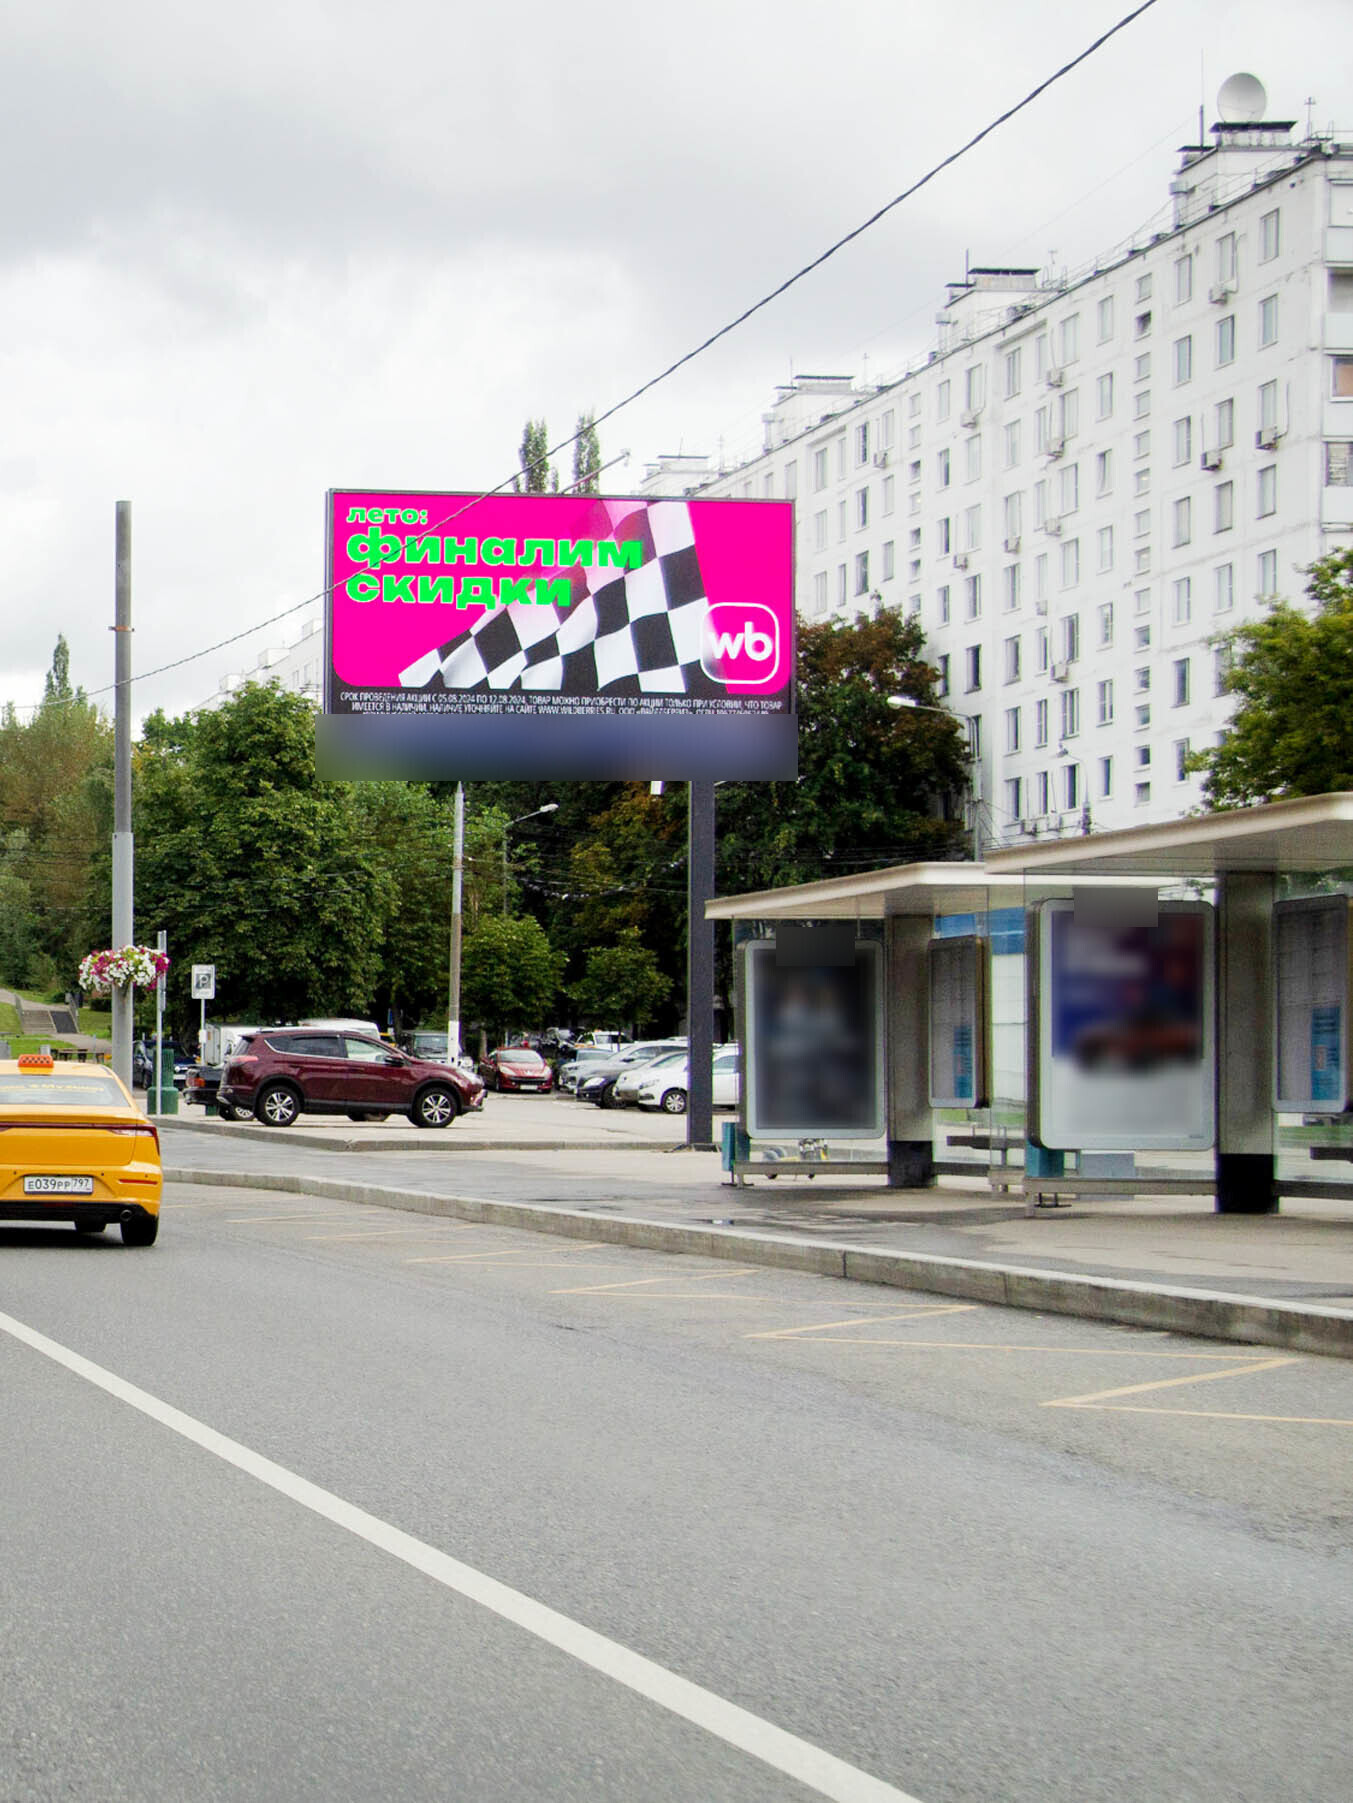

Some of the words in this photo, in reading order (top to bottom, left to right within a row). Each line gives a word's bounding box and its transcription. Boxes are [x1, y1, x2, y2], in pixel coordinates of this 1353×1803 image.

[347, 506, 428, 524] лето:
[346, 527, 643, 569] финалим
[346, 574, 572, 610] скидки
[708, 621, 774, 661] wb
